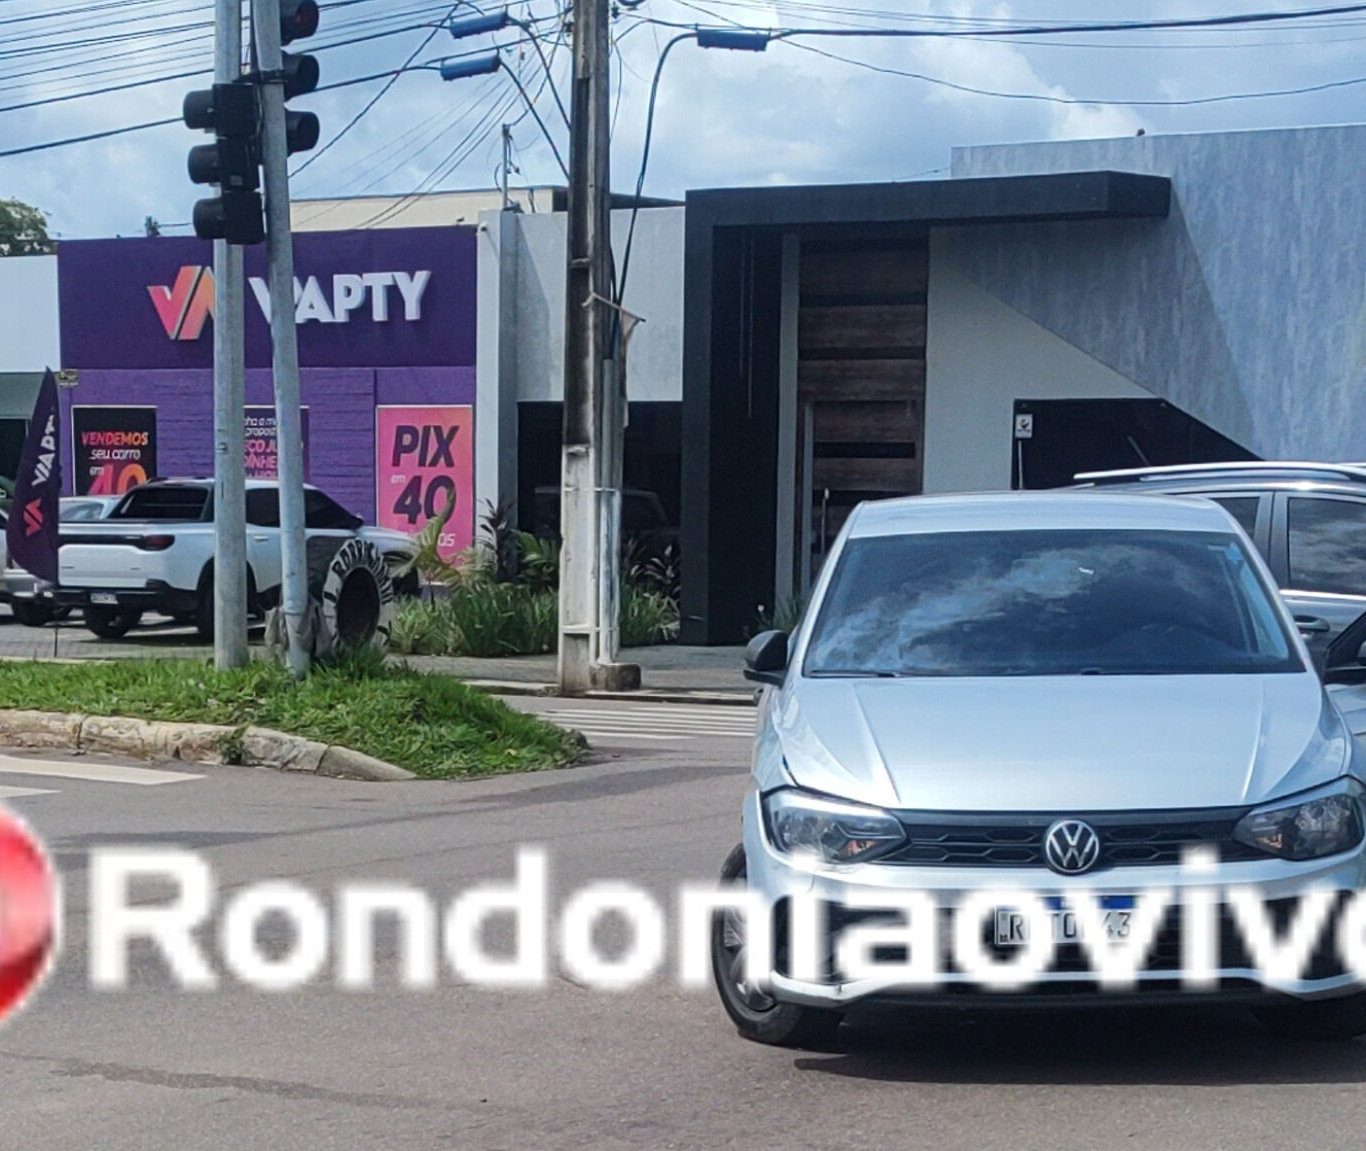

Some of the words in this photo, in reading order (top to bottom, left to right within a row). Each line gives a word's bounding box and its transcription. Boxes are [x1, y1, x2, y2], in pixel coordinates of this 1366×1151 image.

[81, 431, 148, 446] VENDEMOS
[392, 425, 460, 467] PIX
[89, 449, 110, 460] seu
[112, 449, 141, 460] carro
[390, 475, 406, 484] em
[393, 475, 457, 525] 40
